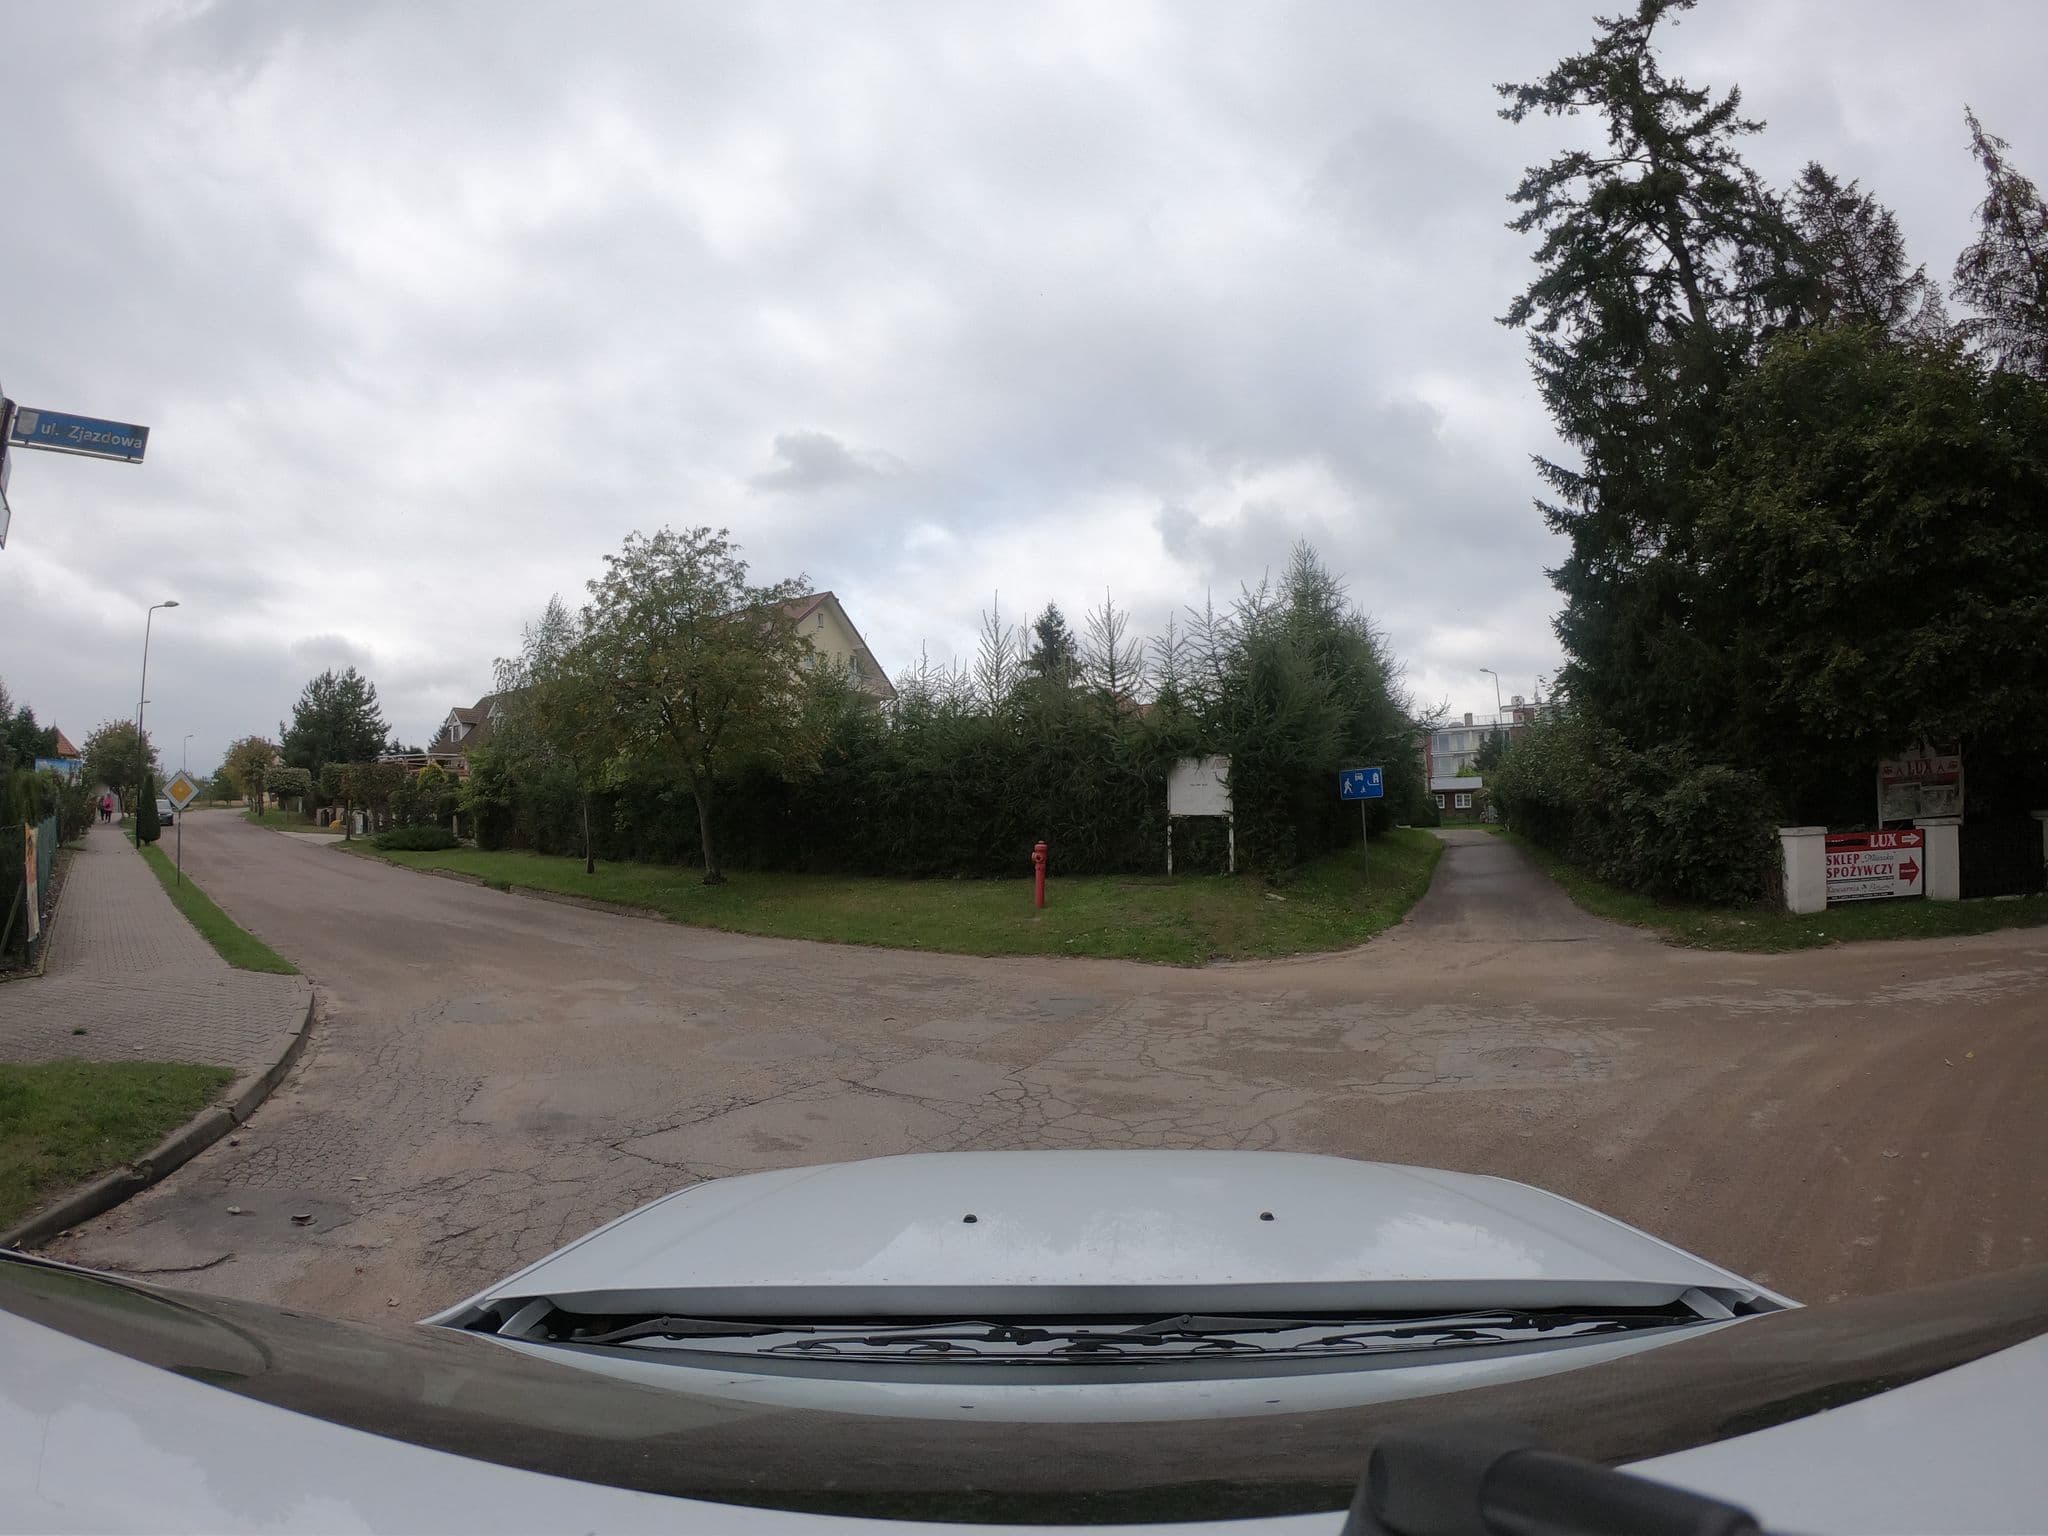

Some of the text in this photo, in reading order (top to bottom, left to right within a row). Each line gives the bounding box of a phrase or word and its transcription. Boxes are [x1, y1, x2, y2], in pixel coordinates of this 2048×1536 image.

[41, 422, 143, 448] ul. Zjazdowa
[1870, 833, 1897, 848] LUX
[1826, 853, 1860, 866] SKLEP
[1826, 863, 1894, 878] SPOŻYWCZY
